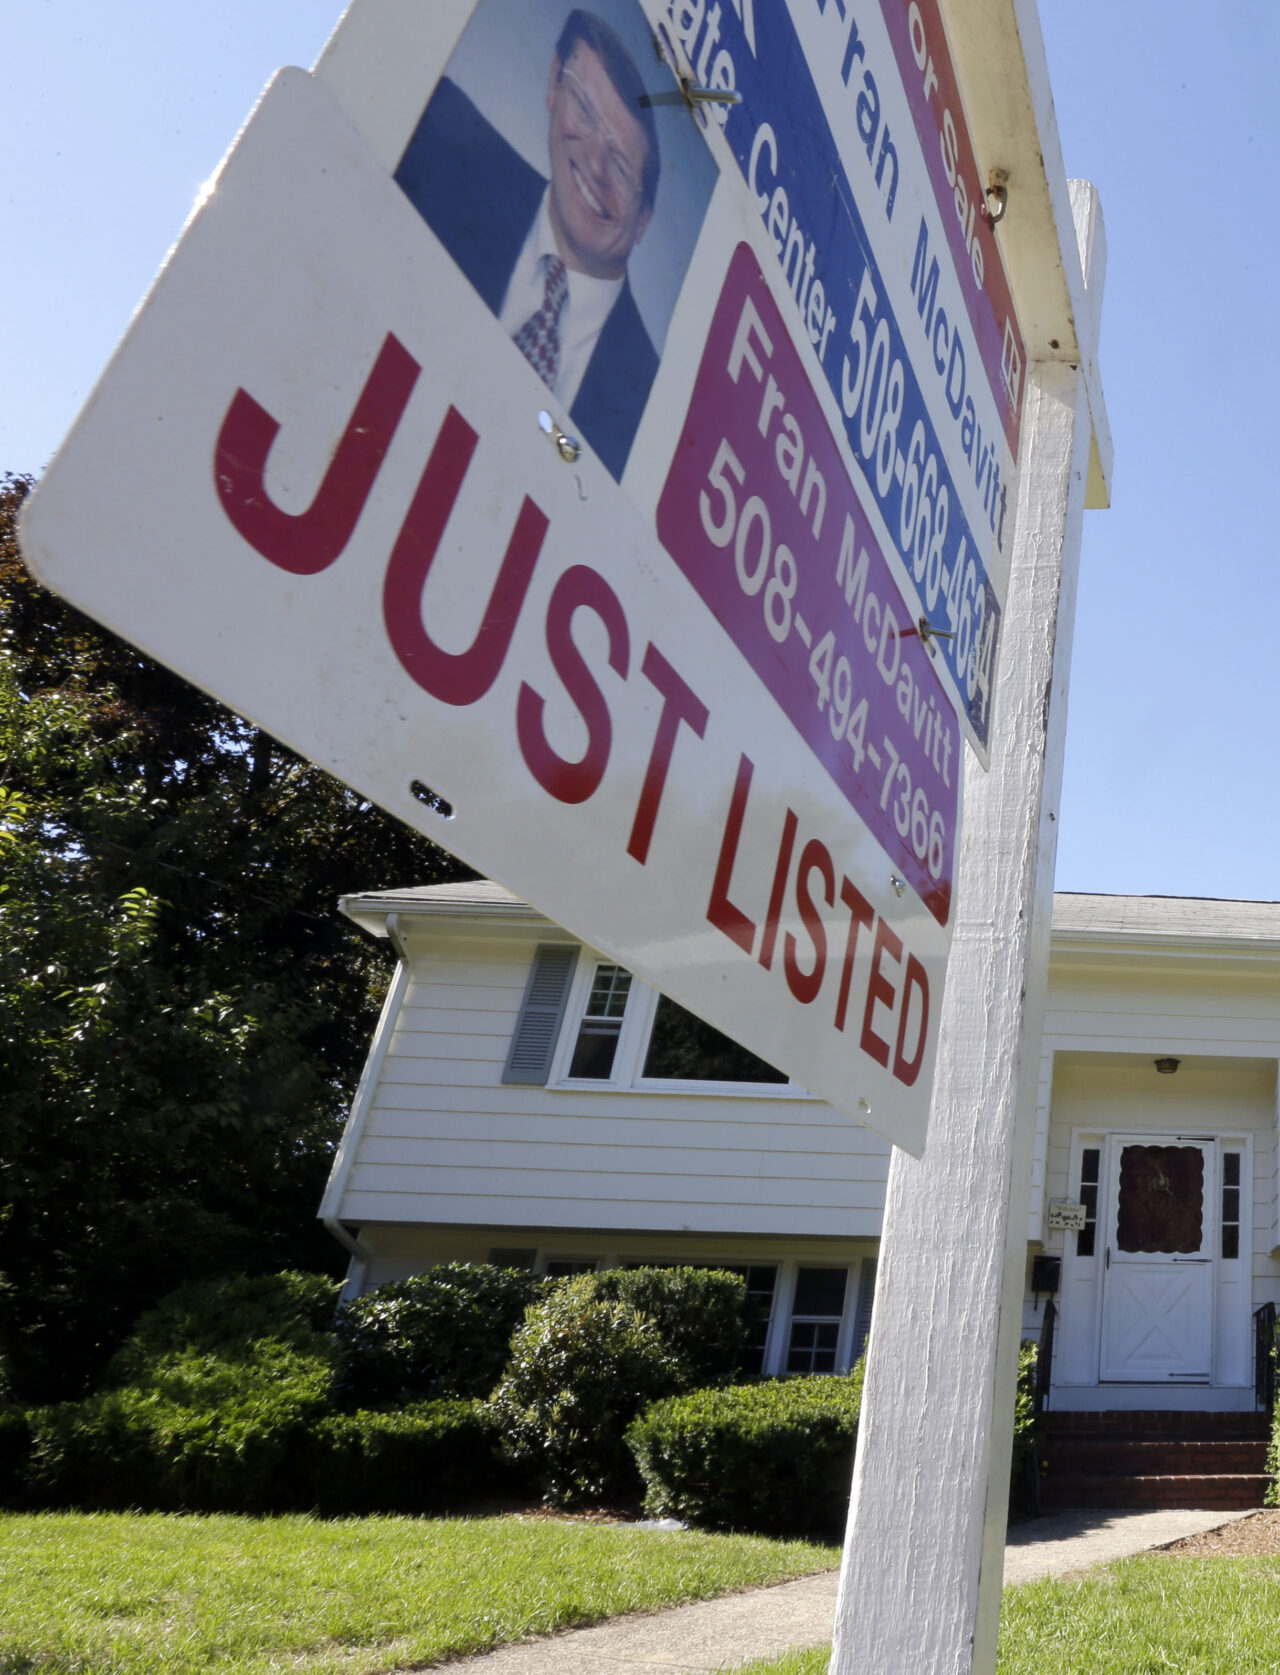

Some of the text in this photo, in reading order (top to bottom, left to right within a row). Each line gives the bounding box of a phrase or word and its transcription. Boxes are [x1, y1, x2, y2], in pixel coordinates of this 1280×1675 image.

[748, 123, 836, 363] Center
[842, 267, 996, 724] 508-668-4634
[816, 0, 1007, 554] ran McDavitt
[939, 109, 984, 290] Sale
[212, 330, 930, 1087] JUST LISTED
[700, 438, 945, 880] 508-494-7366
[727, 294, 952, 788] Fran McDavitt
